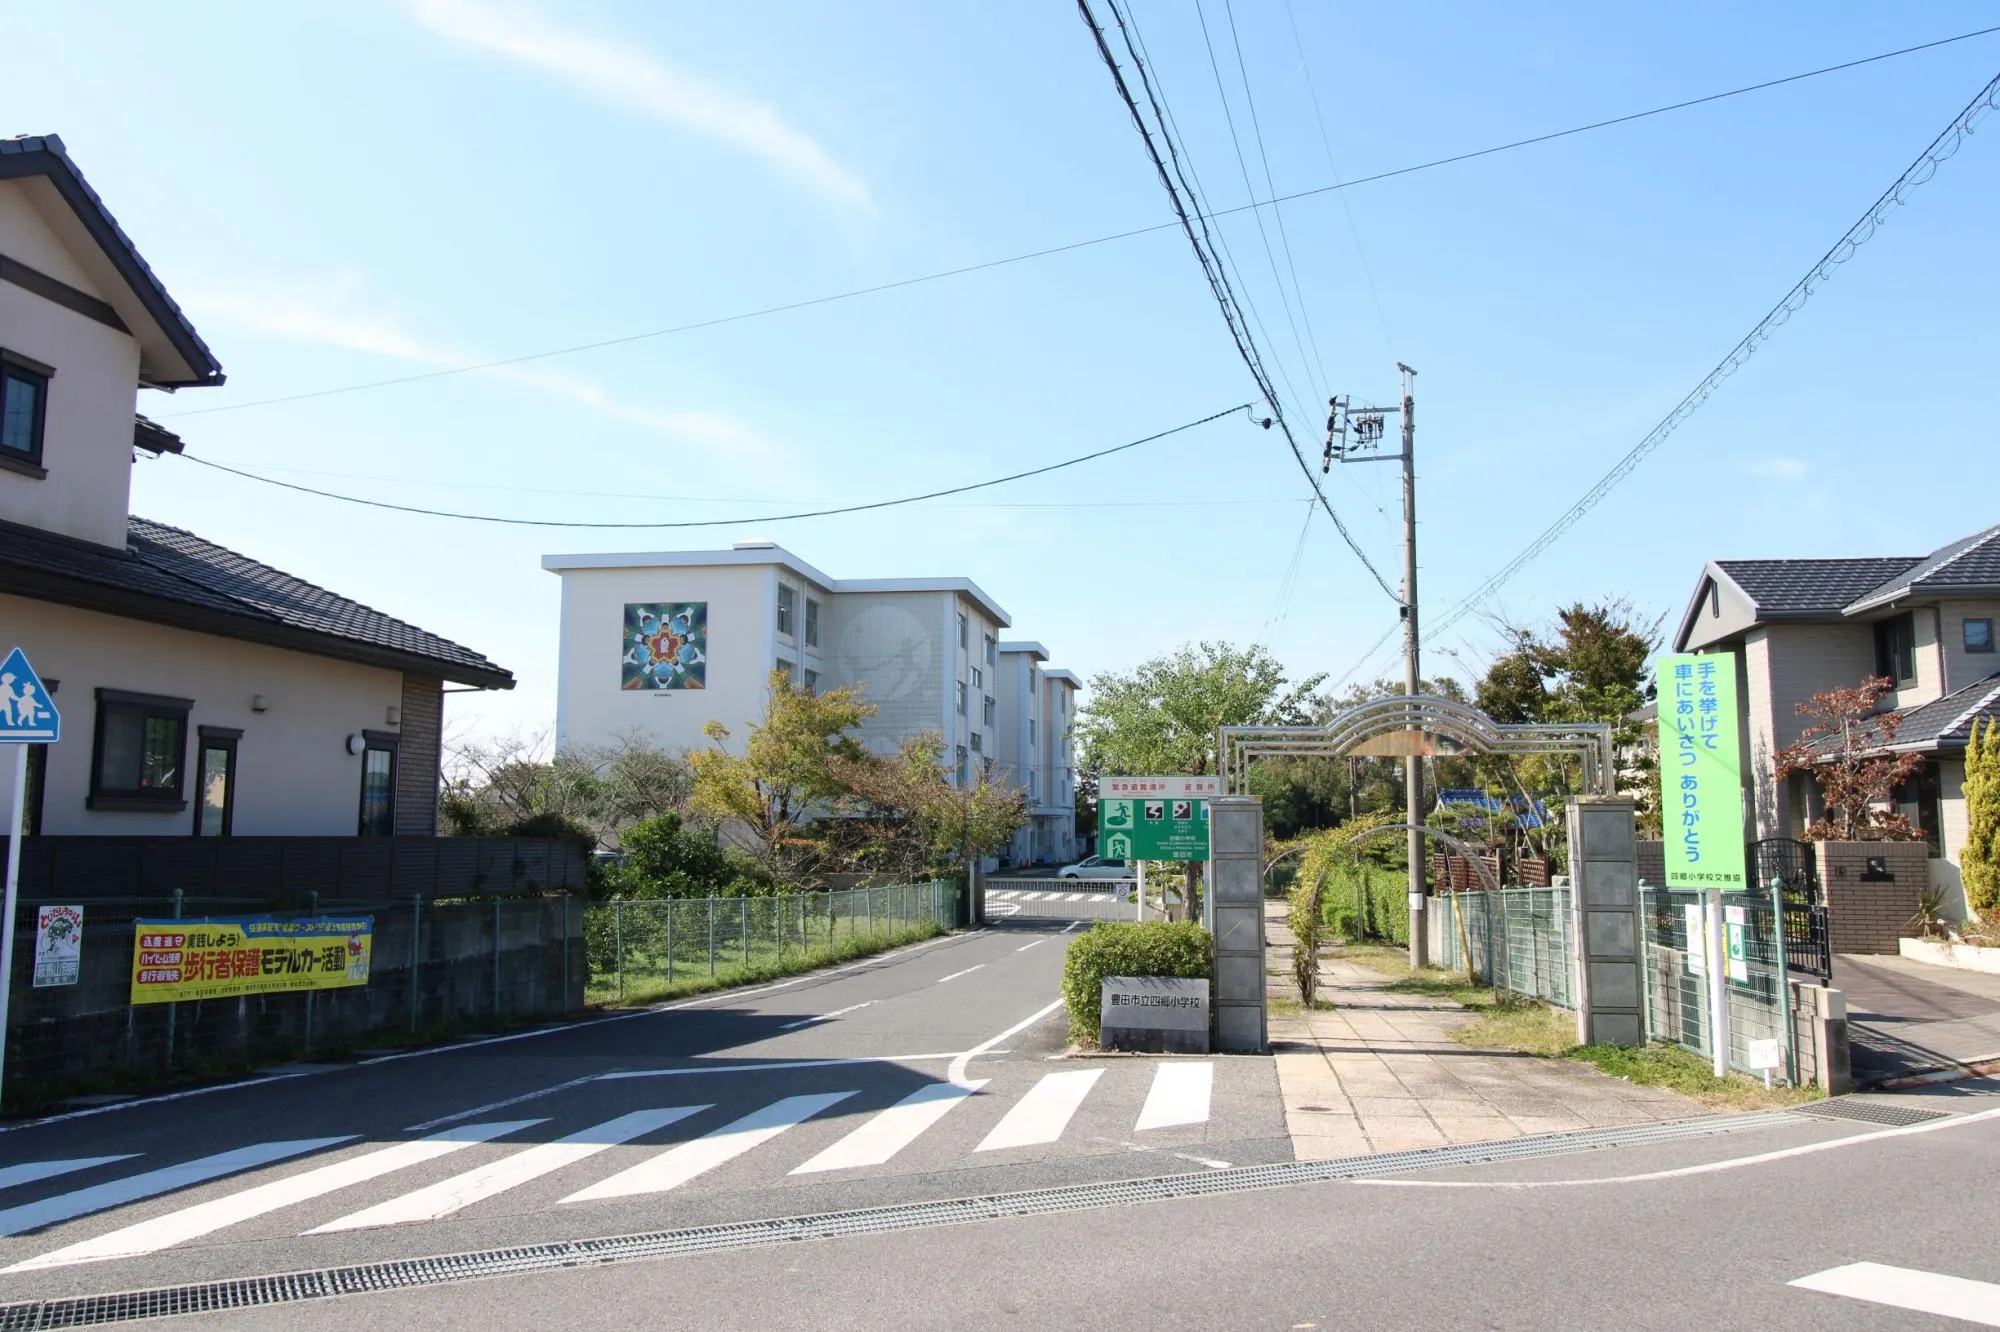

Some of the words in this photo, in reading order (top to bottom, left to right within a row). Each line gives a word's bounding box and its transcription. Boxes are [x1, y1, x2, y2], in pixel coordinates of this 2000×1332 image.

[1674, 664, 1697, 766] 車にあいさつ
[1697, 662, 1718, 750] 手を挙げて
[1680, 774, 1700, 863] ありがとう
[1111, 993, 1200, 1009] 豊田市立四郷小学校
